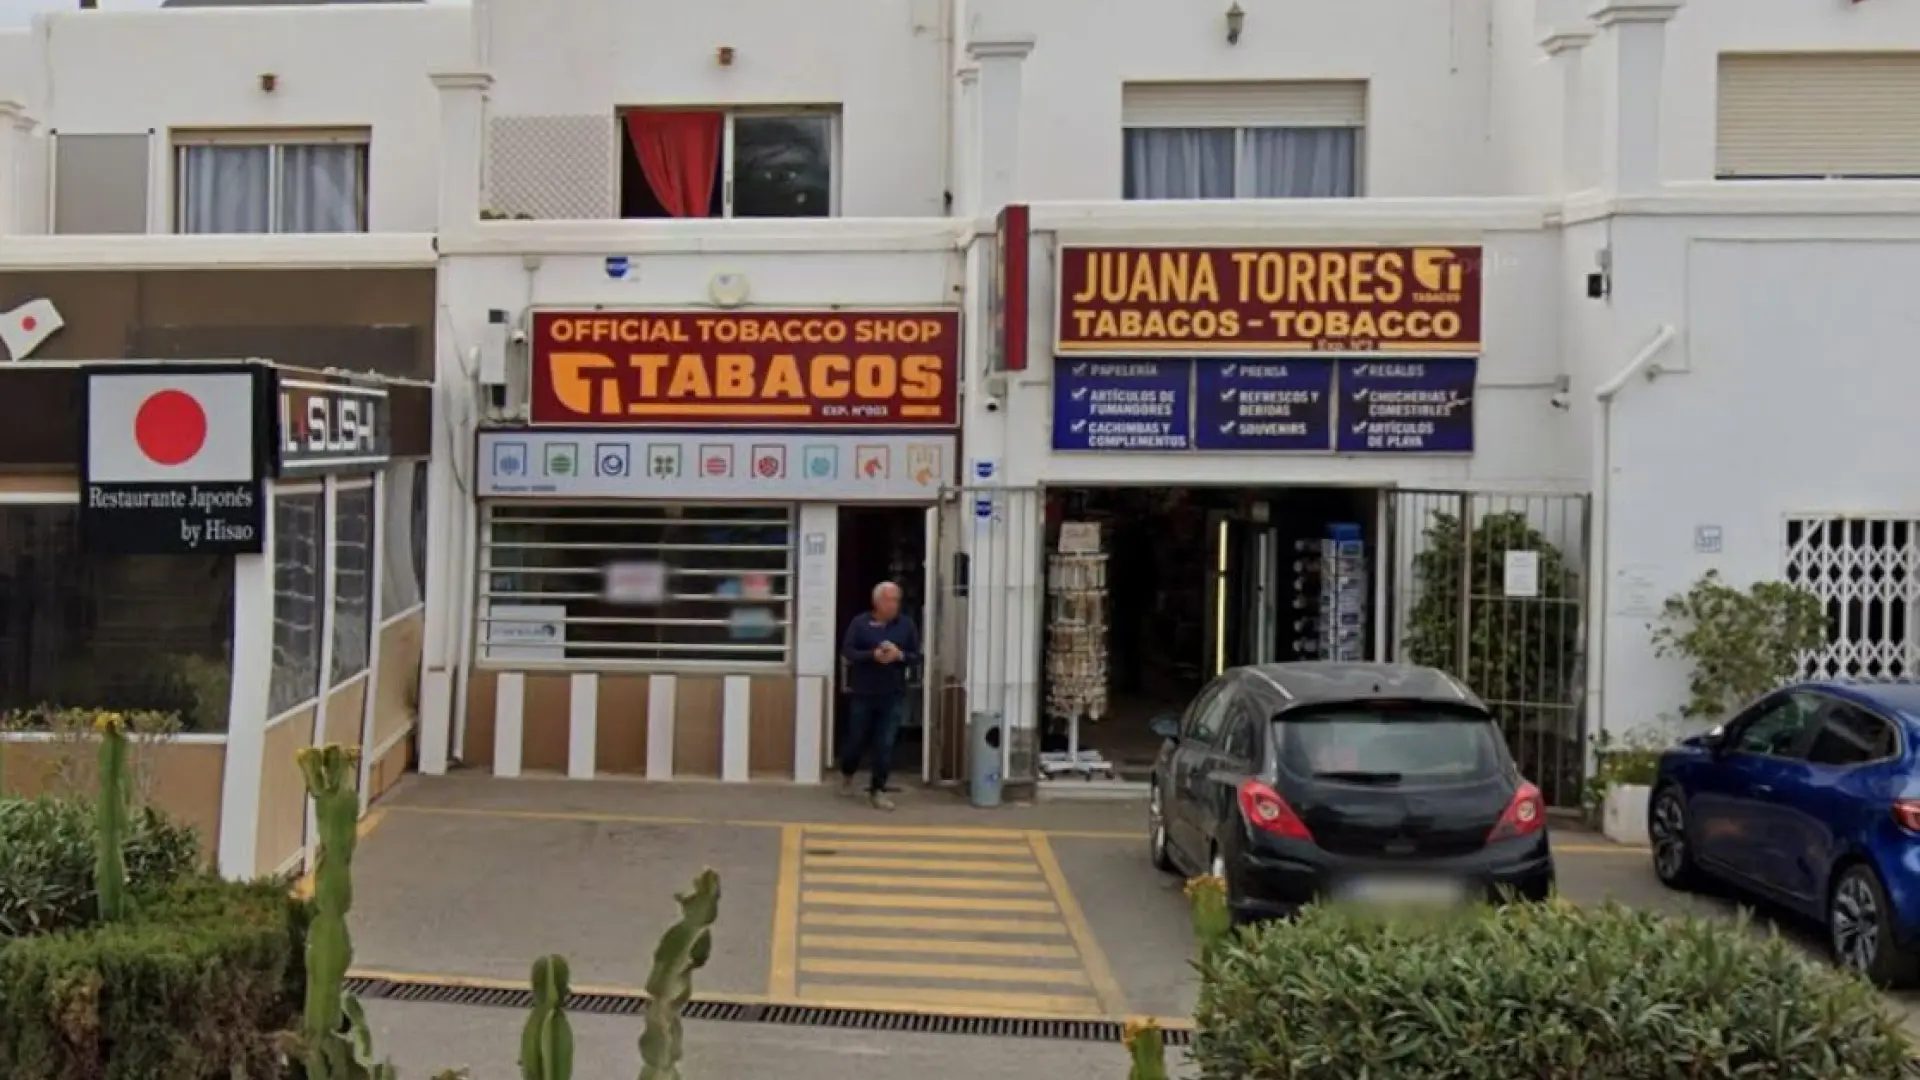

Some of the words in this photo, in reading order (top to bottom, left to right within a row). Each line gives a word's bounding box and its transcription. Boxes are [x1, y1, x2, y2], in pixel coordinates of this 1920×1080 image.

[1073, 252, 1220, 303] JUANA
[1232, 252, 1403, 304] TORRES
[1073, 309, 1240, 338] TABACOS
[1270, 310, 1460, 338] TOBACCO
[550, 319, 689, 342] OFFICIAL
[696, 319, 847, 343] TOBACCO
[855, 319, 942, 343] SHOP
[629, 354, 942, 399] TABACOS
[1239, 366, 1289, 377] PRENSA
[1369, 364, 1425, 377] REGALOS
[1159, 390, 1176, 402] DE
[1239, 390, 1308, 403] REFRESCOS
[1310, 390, 1319, 403] Y
[1449, 390, 1458, 402] Y
[1239, 404, 1290, 416] BEBIDAS
[1368, 404, 1451, 416] COMESTIBLES
[1089, 421, 1159, 434] CACHIMBAS
[1161, 422, 1171, 434] Y
[1239, 422, 1307, 435] SOUVENIRS
[1088, 435, 1187, 447] COMPLEMENTOS
[1367, 435, 1383, 447] DE
[1386, 435, 1424, 447] PLAYA
[89, 486, 187, 508] Restaurante
[189, 485, 253, 514] Japonés
[180, 518, 202, 547] by
[205, 519, 254, 541] Hisao
